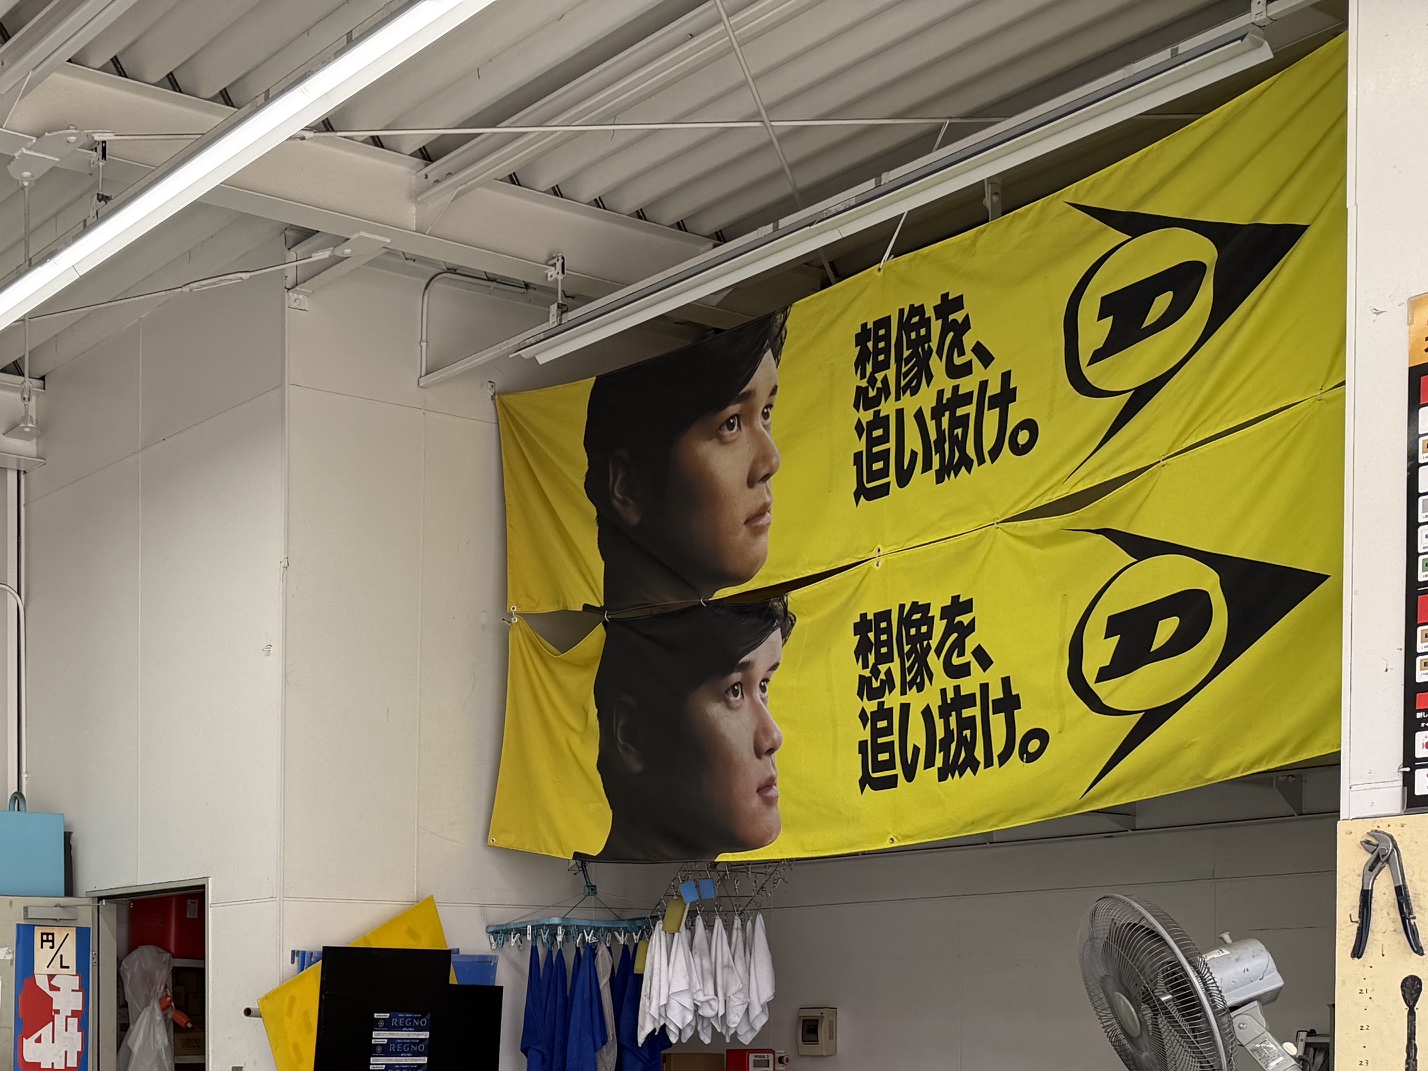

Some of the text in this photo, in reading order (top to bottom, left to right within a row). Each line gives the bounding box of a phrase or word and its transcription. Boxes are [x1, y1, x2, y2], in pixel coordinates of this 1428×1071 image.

[853, 291, 995, 412] 想像を、
[853, 377, 1040, 508] 追い抜け。
[853, 594, 993, 701] 想像を、
[856, 668, 1050, 795] 追い抜け。
[389, 1043, 425, 1052] REGNO
[391, 1018, 427, 1026] REGNO
